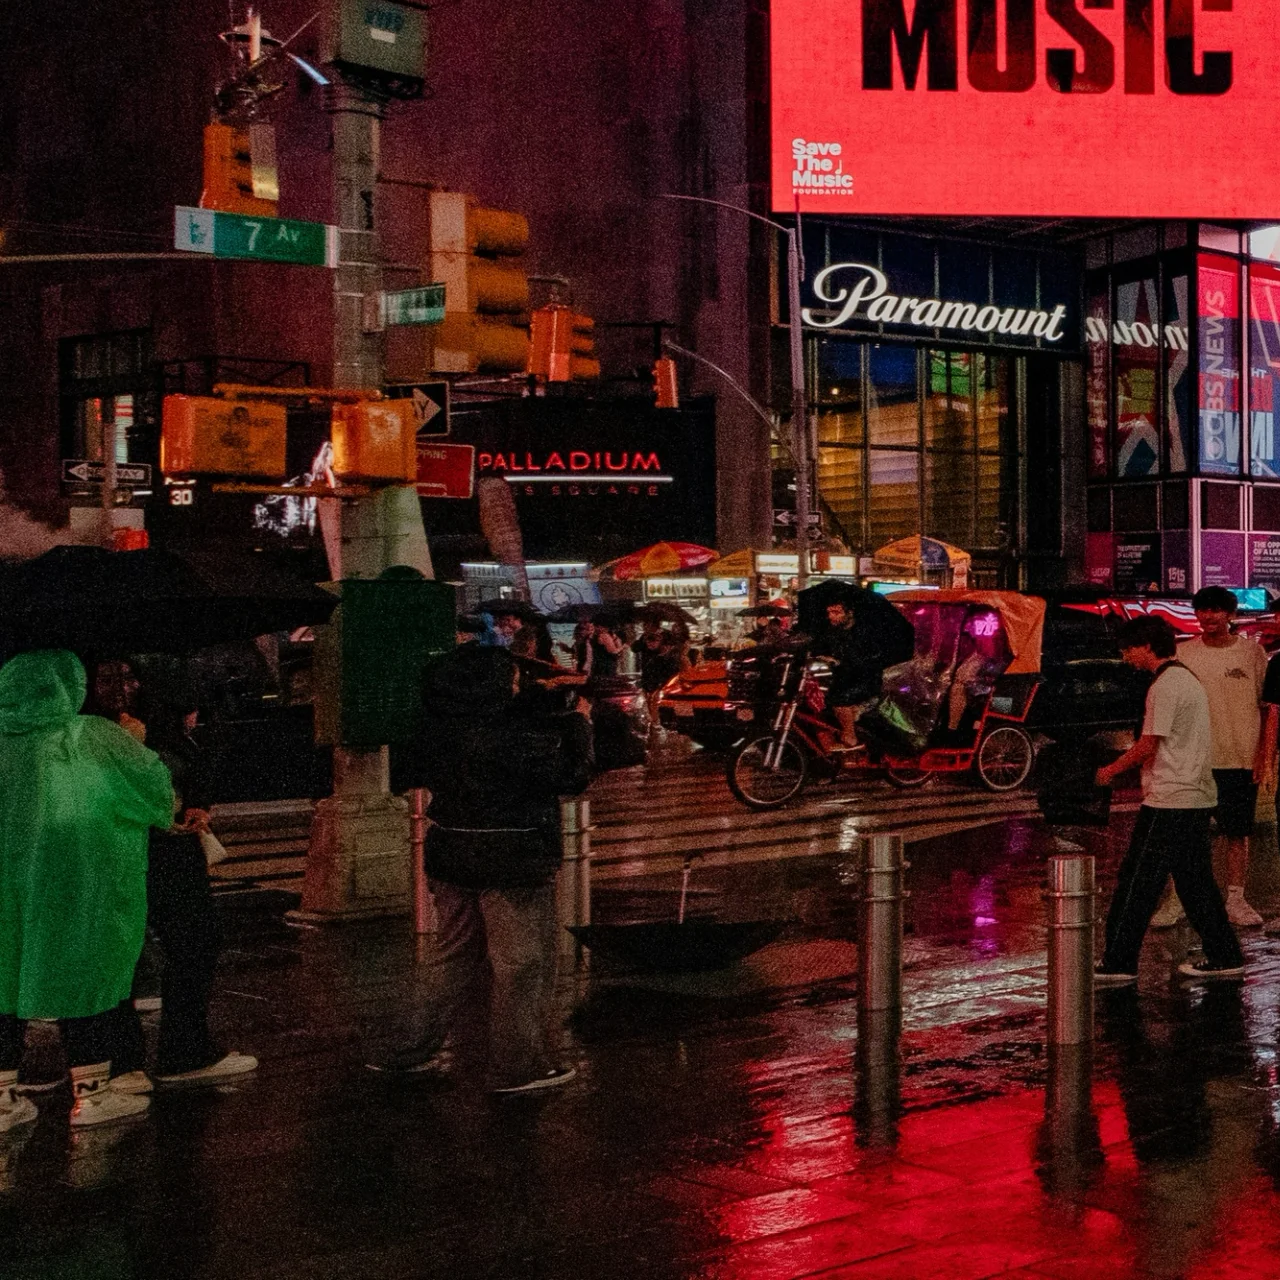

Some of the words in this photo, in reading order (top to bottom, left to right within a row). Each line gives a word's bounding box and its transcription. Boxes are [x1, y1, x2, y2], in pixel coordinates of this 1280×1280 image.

[792, 138, 842, 155] Save
[792, 154, 833, 171] The
[792, 170, 854, 187] Music
[245, 221, 262, 251] 7
[277, 224, 300, 242] Av
[802, 262, 1066, 341] Paramount
[1206, 289, 1225, 373] NEWS
[478, 451, 661, 470] PALLADIUM
[171, 488, 193, 505] 30
